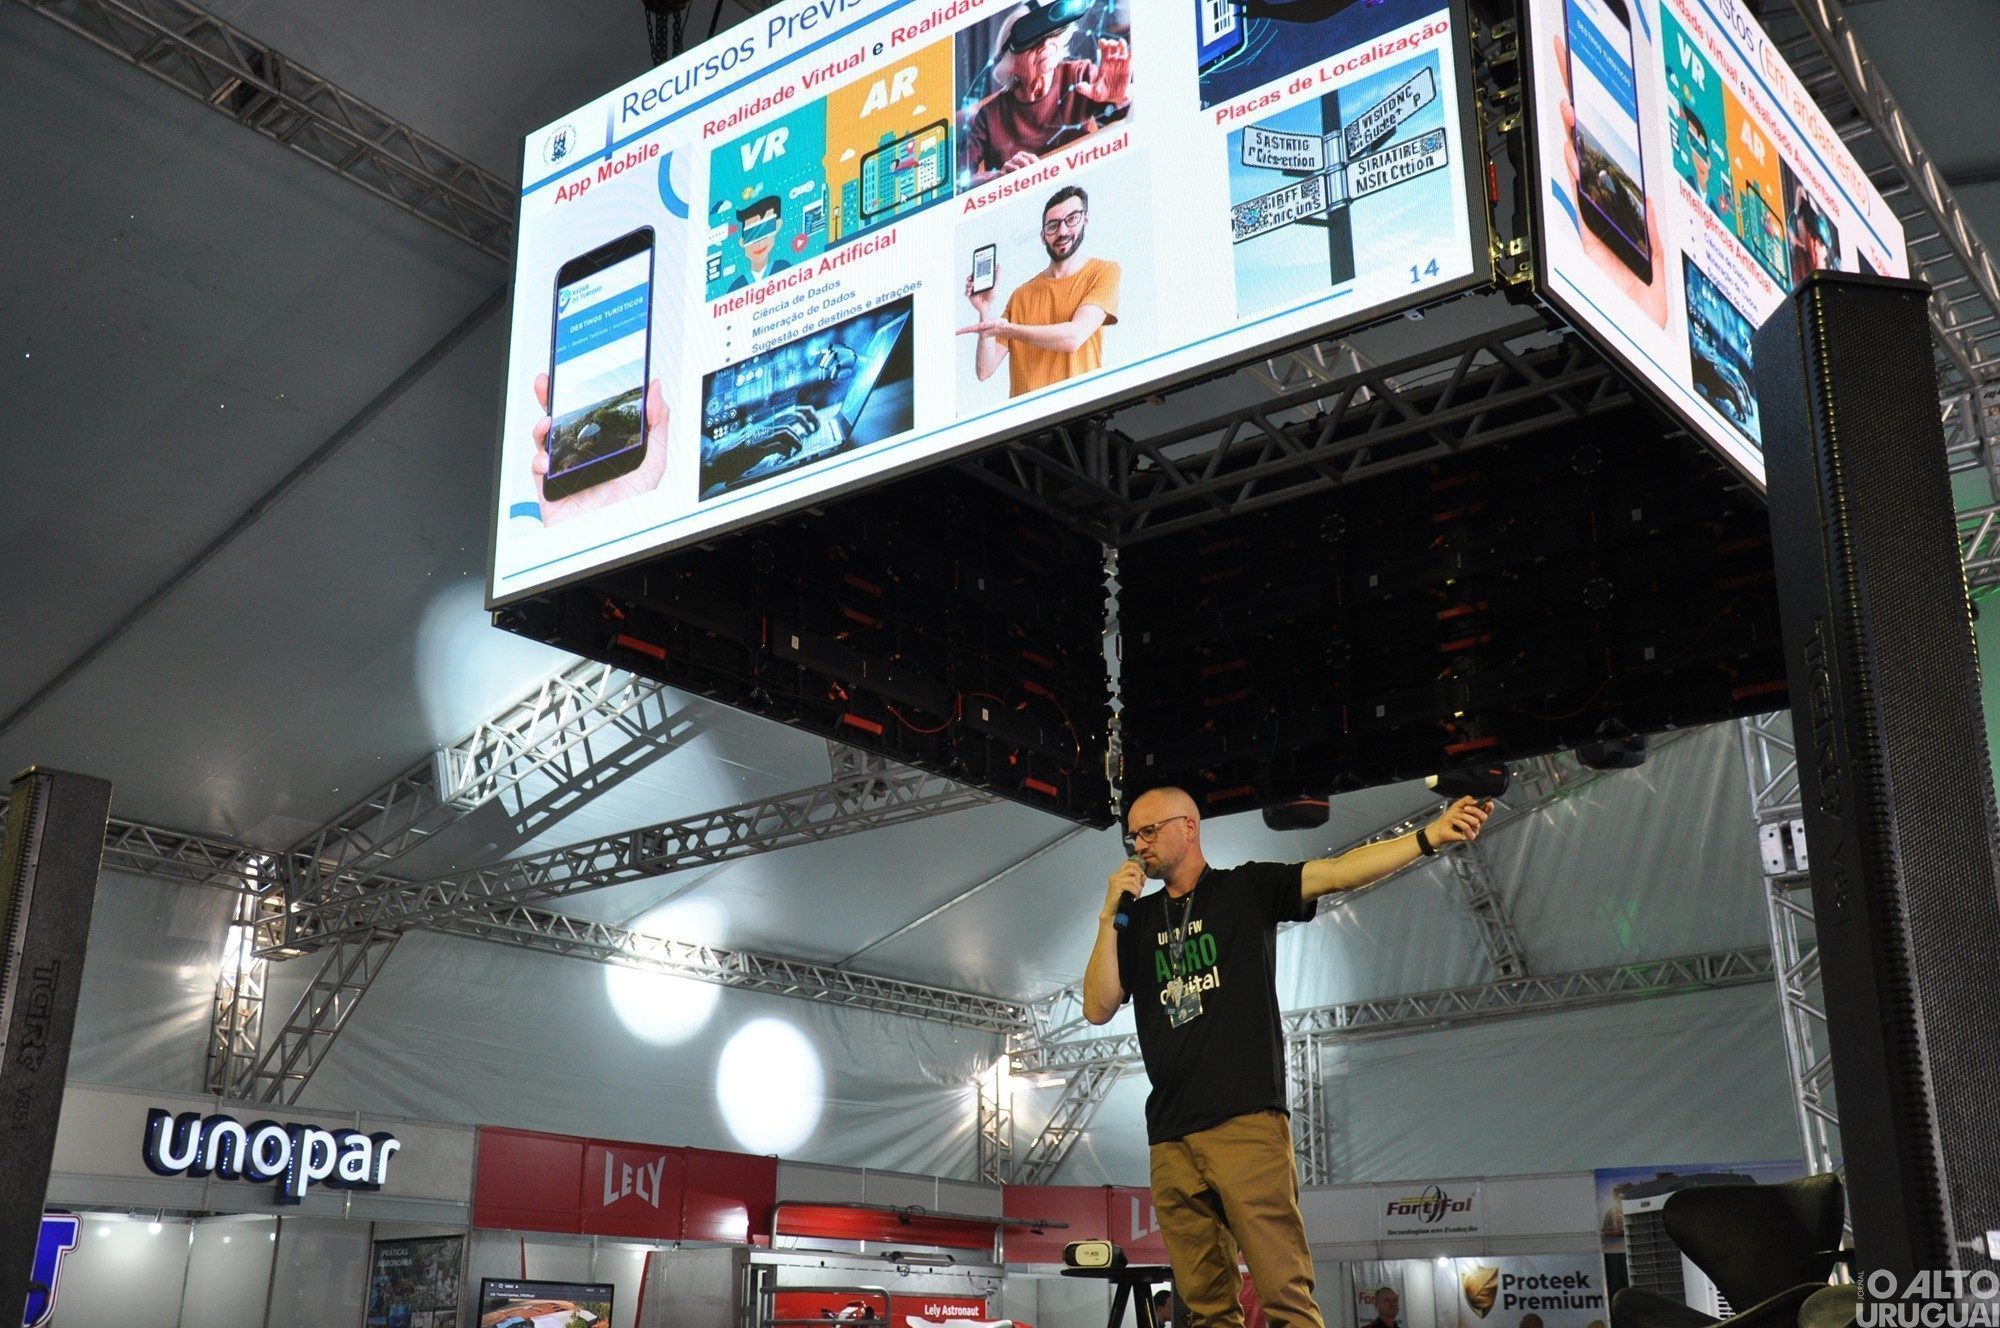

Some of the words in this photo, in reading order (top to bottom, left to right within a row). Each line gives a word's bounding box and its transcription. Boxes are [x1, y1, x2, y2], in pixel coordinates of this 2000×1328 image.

[622, 37, 755, 123] Recursos
[1215, 90, 1281, 125] Placas
[1289, 76, 1313, 95] de
[1319, 20, 1449, 82] Localização
[1677, 32, 1705, 92] VR
[1706, 30, 1738, 84] Virtual
[703, 85, 795, 139] Realidade
[802, 47, 866, 91] Virtual
[872, 42, 884, 56] e
[859, 66, 919, 119] AR
[740, 126, 790, 172] VR
[1740, 118, 1766, 168] AR
[555, 177, 592, 204] App
[597, 143, 660, 183] Mobile
[964, 165, 1060, 214] Assistente
[1066, 132, 1129, 170] Virtual
[713, 268, 813, 318] Inteligência
[818, 228, 896, 275] Artificial
[1410, 258, 1440, 284] 14
[569, 313, 603, 334] DESTINOS
[752, 309, 804, 338] Mineração
[807, 304, 820, 316] de
[822, 290, 857, 310] Dados
[752, 327, 799, 354] Sugestão
[802, 320, 815, 333] de
[817, 303, 863, 326] destinos
[865, 301, 872, 309] e
[875, 280, 923, 305] atrações
[753, 300, 790, 321] Ciência
[792, 293, 805, 305] de
[808, 280, 841, 299] Dados
[1188, 919, 1203, 936] FW
[1160, 966, 1220, 1006] dital
[148, 1109, 401, 1202] unopar
[603, 1150, 666, 1209] LELY
[1131, 1196, 1160, 1242] LE
[1387, 1228, 1429, 1237] Tecnologias
[1444, 1225, 1478, 1234] Evolução
[1358, 1291, 1376, 1305] For
[1502, 1271, 1591, 1291] Proteek
[1503, 1290, 1604, 1311] Premium
[924, 1304, 941, 1317] Lely
[941, 1304, 980, 1317] Astronaut
